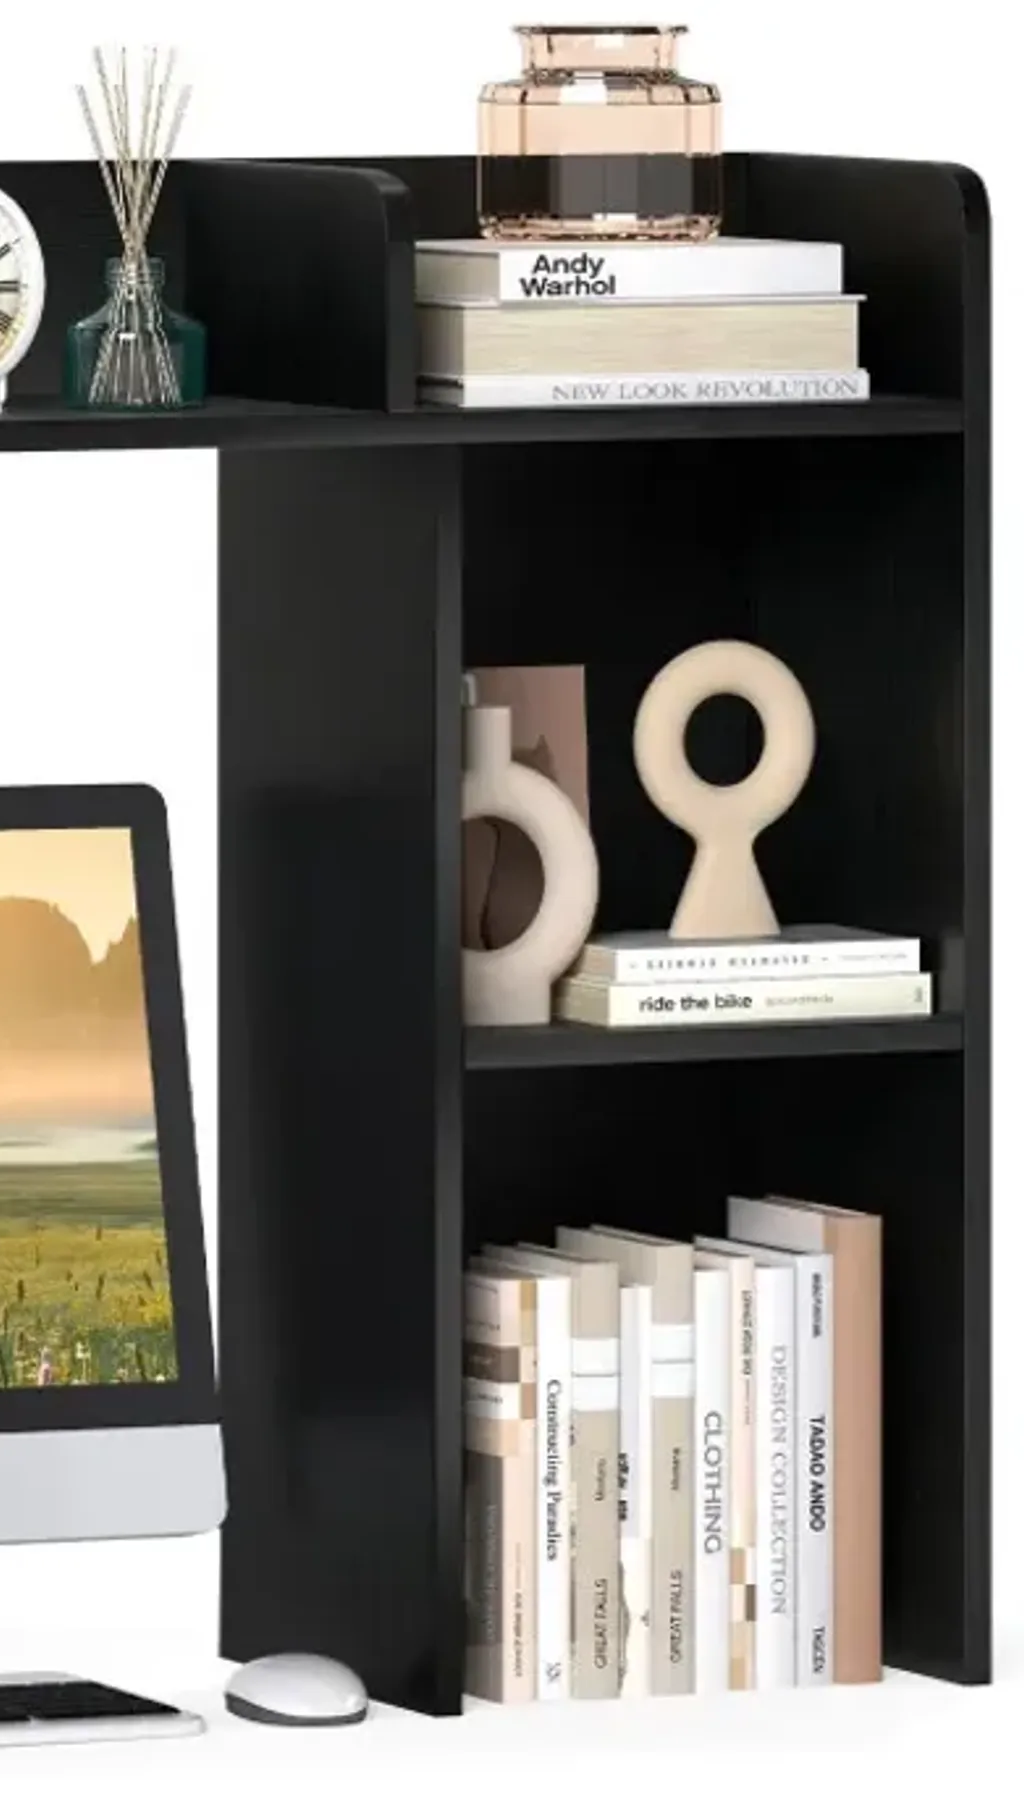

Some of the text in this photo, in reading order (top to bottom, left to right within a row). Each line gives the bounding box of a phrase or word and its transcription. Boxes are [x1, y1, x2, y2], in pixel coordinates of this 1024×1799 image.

[520, 274, 616, 297] Warhol
[531, 252, 605, 277] Andy
[552, 378, 860, 400] NEW LOOK REVOLUTION
[639, 996, 675, 1013] ride
[679, 995, 710, 1012] the
[714, 993, 753, 1010] bike
[544, 1379, 563, 1486] Constructing
[808, 1415, 826, 1533] TADAO ANDO
[703, 1411, 724, 1555] CLOTHING
[770, 1344, 789, 1616] DESIGN COLLECTION
[593, 1577, 609, 1669] GREAT FALLS
[669, 1569, 684, 1664] GREAT FALLS
